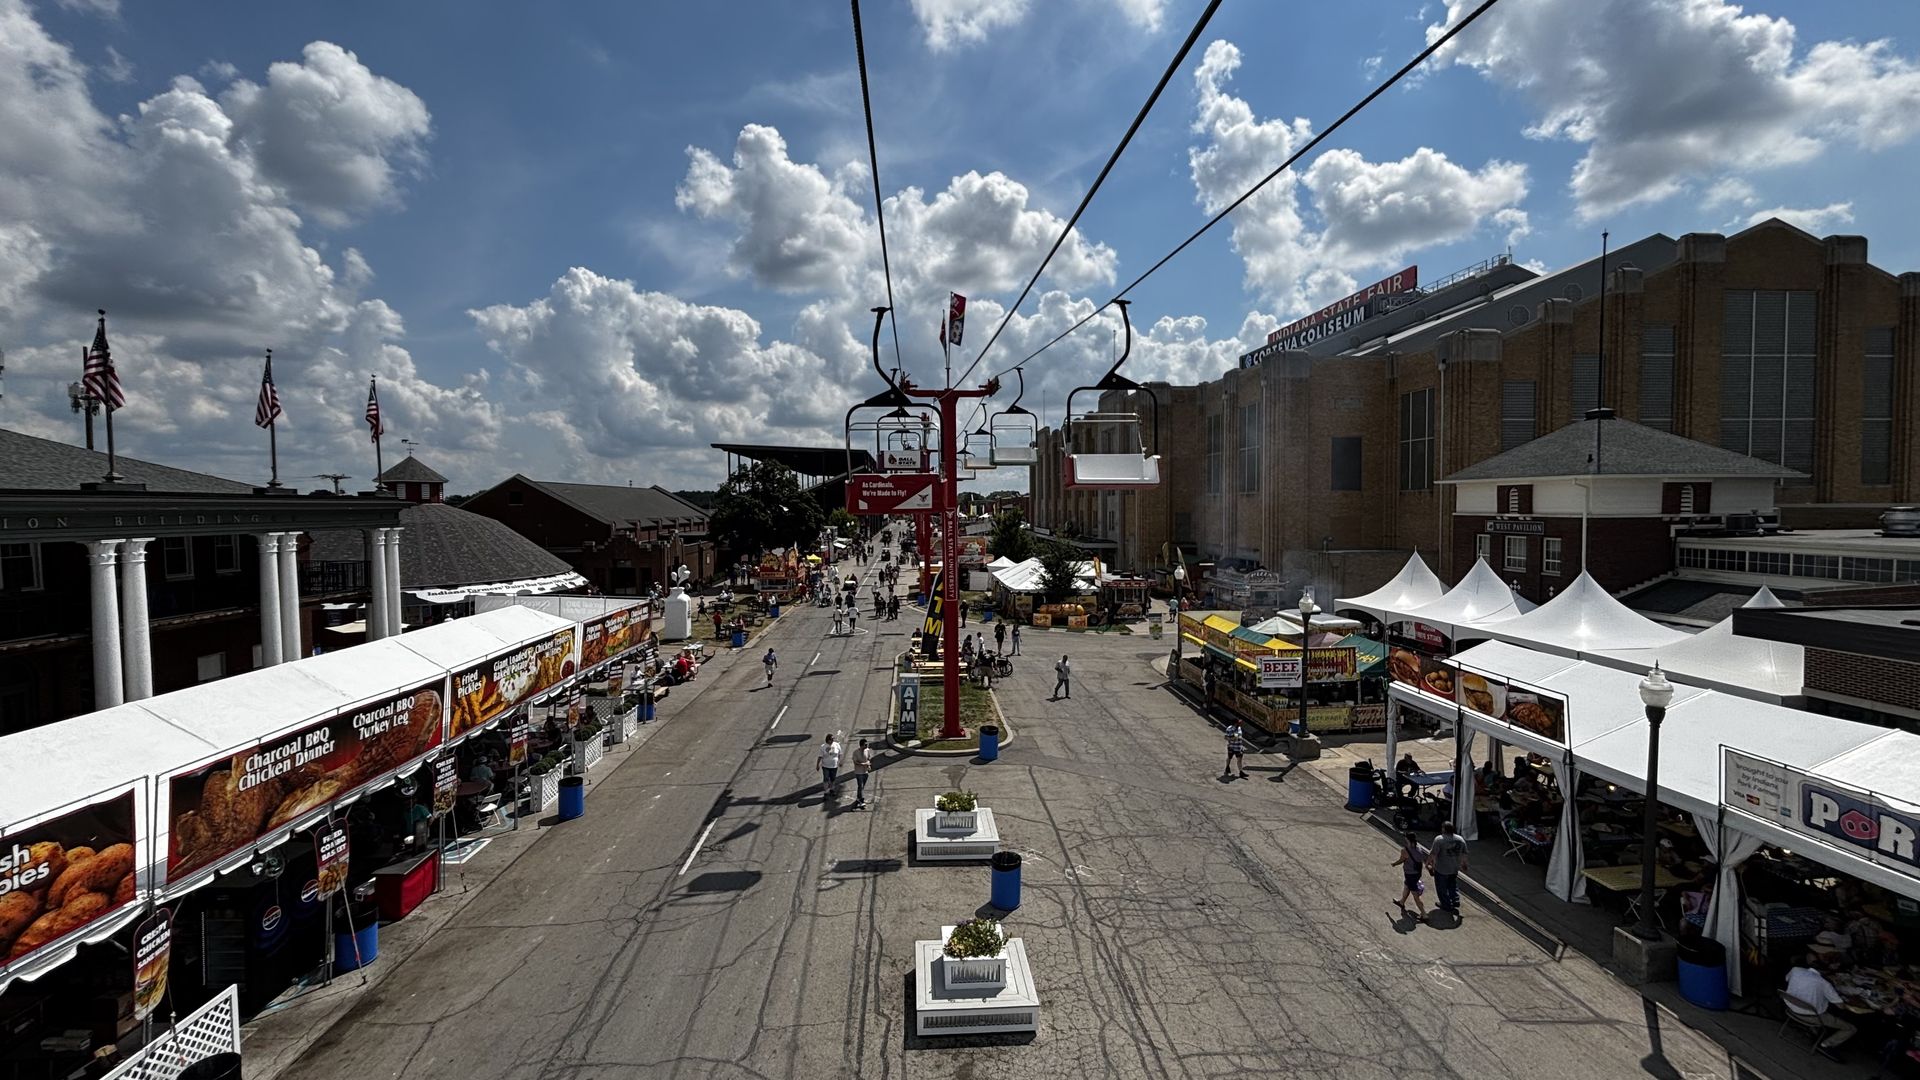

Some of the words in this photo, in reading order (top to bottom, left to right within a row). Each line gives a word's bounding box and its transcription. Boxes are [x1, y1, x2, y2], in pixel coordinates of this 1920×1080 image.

[1273, 316, 1316, 342] INDIANA
[1323, 296, 1360, 319] STATE
[1368, 275, 1402, 300] FAIR
[1301, 306, 1365, 346] COLISEUM
[115, 514, 260, 526] BUILDING
[1512, 524, 1542, 532] PAVILION
[428, 588, 466, 596] Indiana
[924, 582, 944, 636] TM
[536, 640, 554, 654] Chicken
[494, 657, 508, 672] Giant
[509, 650, 528, 665] Loaded
[1263, 662, 1299, 672] BEEF.
[461, 669, 479, 688] Fried
[494, 666, 510, 682] Baked
[458, 680, 483, 698] Pickles
[352, 702, 394, 729] Charcoal
[396, 695, 415, 712] BBQ
[901, 686, 916, 722] ATM
[358, 718, 391, 741] Turkey
[393, 711, 409, 728] Leg
[245, 735, 302, 773] Charcoal
[305, 726, 330, 748] BBQ
[238, 758, 292, 792] Chicken
[294, 740, 336, 767] Dinner
[1736, 762, 1765, 777] brought
[1742, 772, 1751, 781] by
[0, 844, 30, 874] sh
[136, 928, 170, 958] CHICKEN
[141, 920, 168, 945] CRISPY
